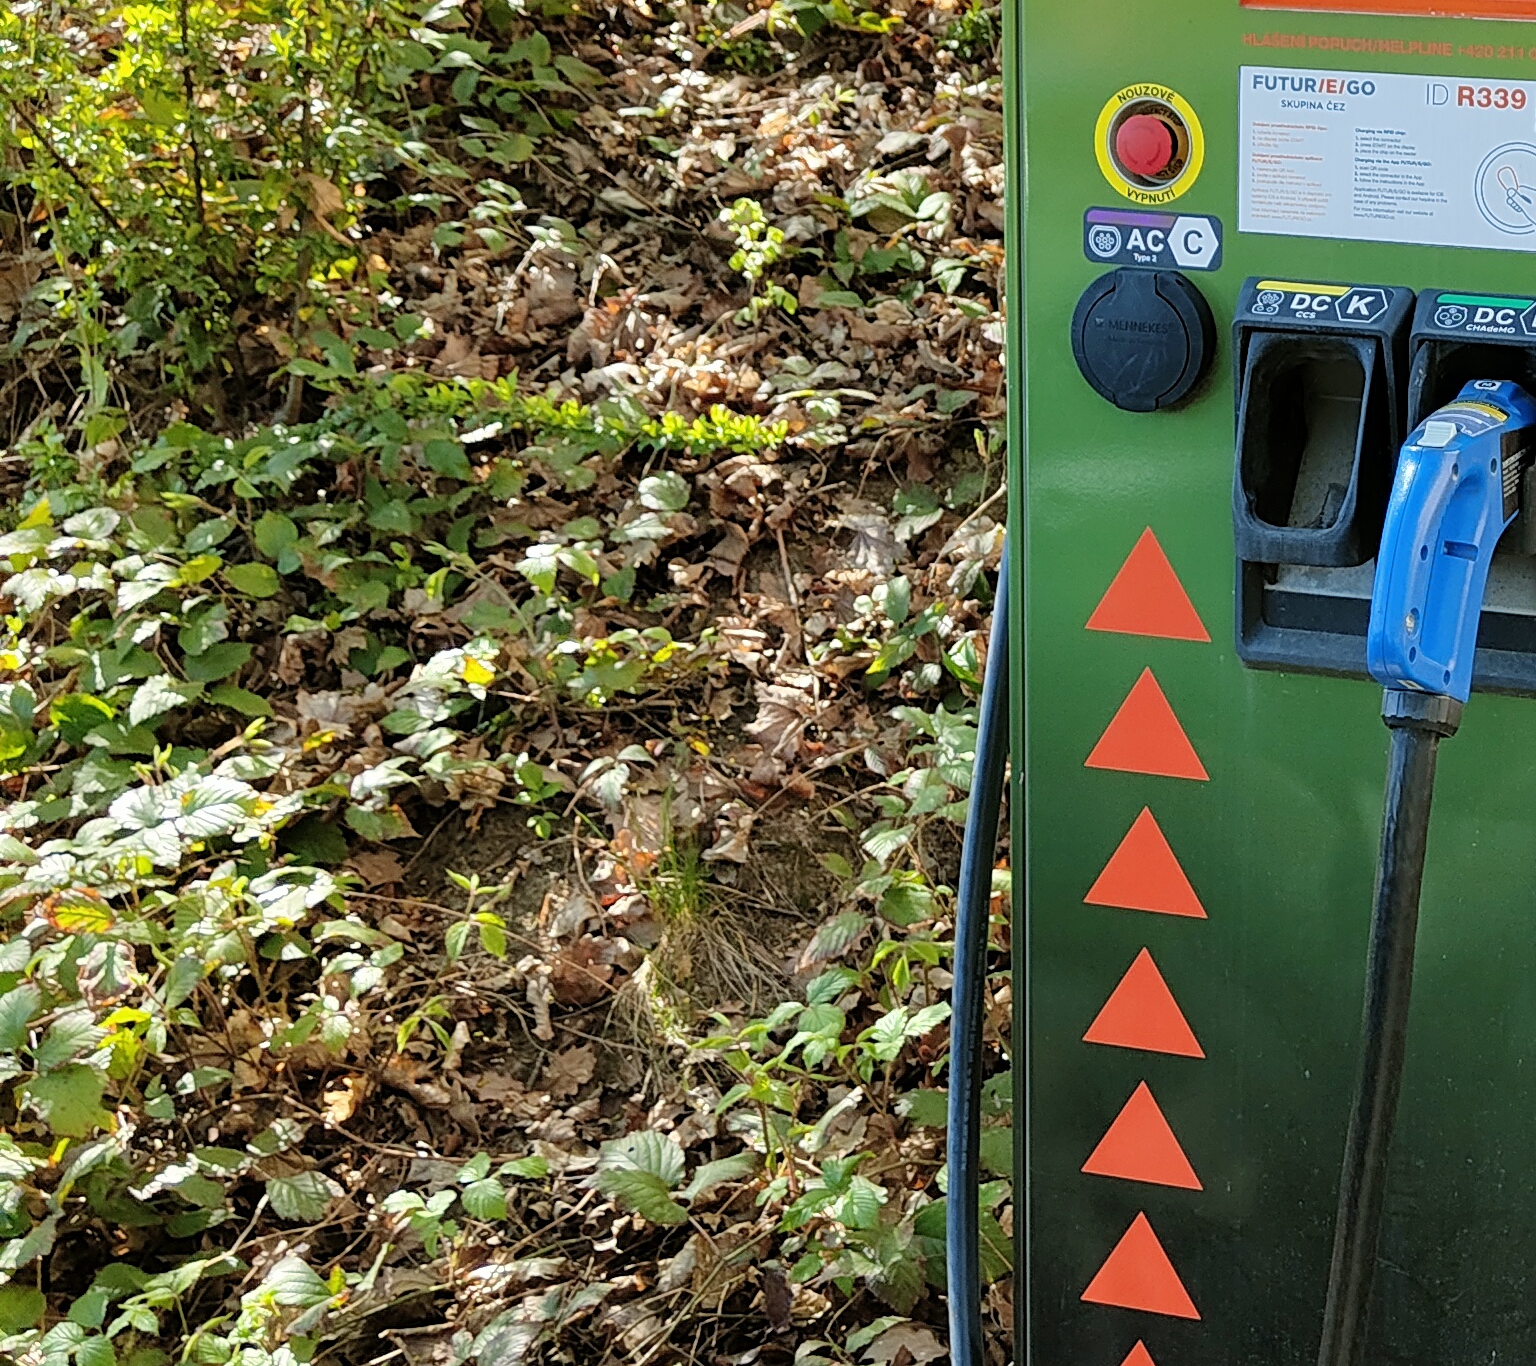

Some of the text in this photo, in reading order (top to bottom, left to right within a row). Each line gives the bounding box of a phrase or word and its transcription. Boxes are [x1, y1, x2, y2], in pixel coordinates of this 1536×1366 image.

[1252, 74, 1376, 96] FUTUR/E/GO
[1117, 85, 1175, 104] NOUZOVÉ
[1426, 83, 1527, 110] ID R339
[1281, 99, 1346, 112] SKUPINA ČEZ
[1127, 186, 1176, 203] VYPNUTÍ
[1126, 228, 1203, 255] AC C
[1133, 252, 1151, 263] Type
[1290, 293, 1376, 316] DC K
[1295, 310, 1317, 319] CCS
[1474, 307, 1516, 325] DC
[1108, 319, 1169, 334] MENNEKES
[1465, 323, 1516, 334] CHAdeMO
